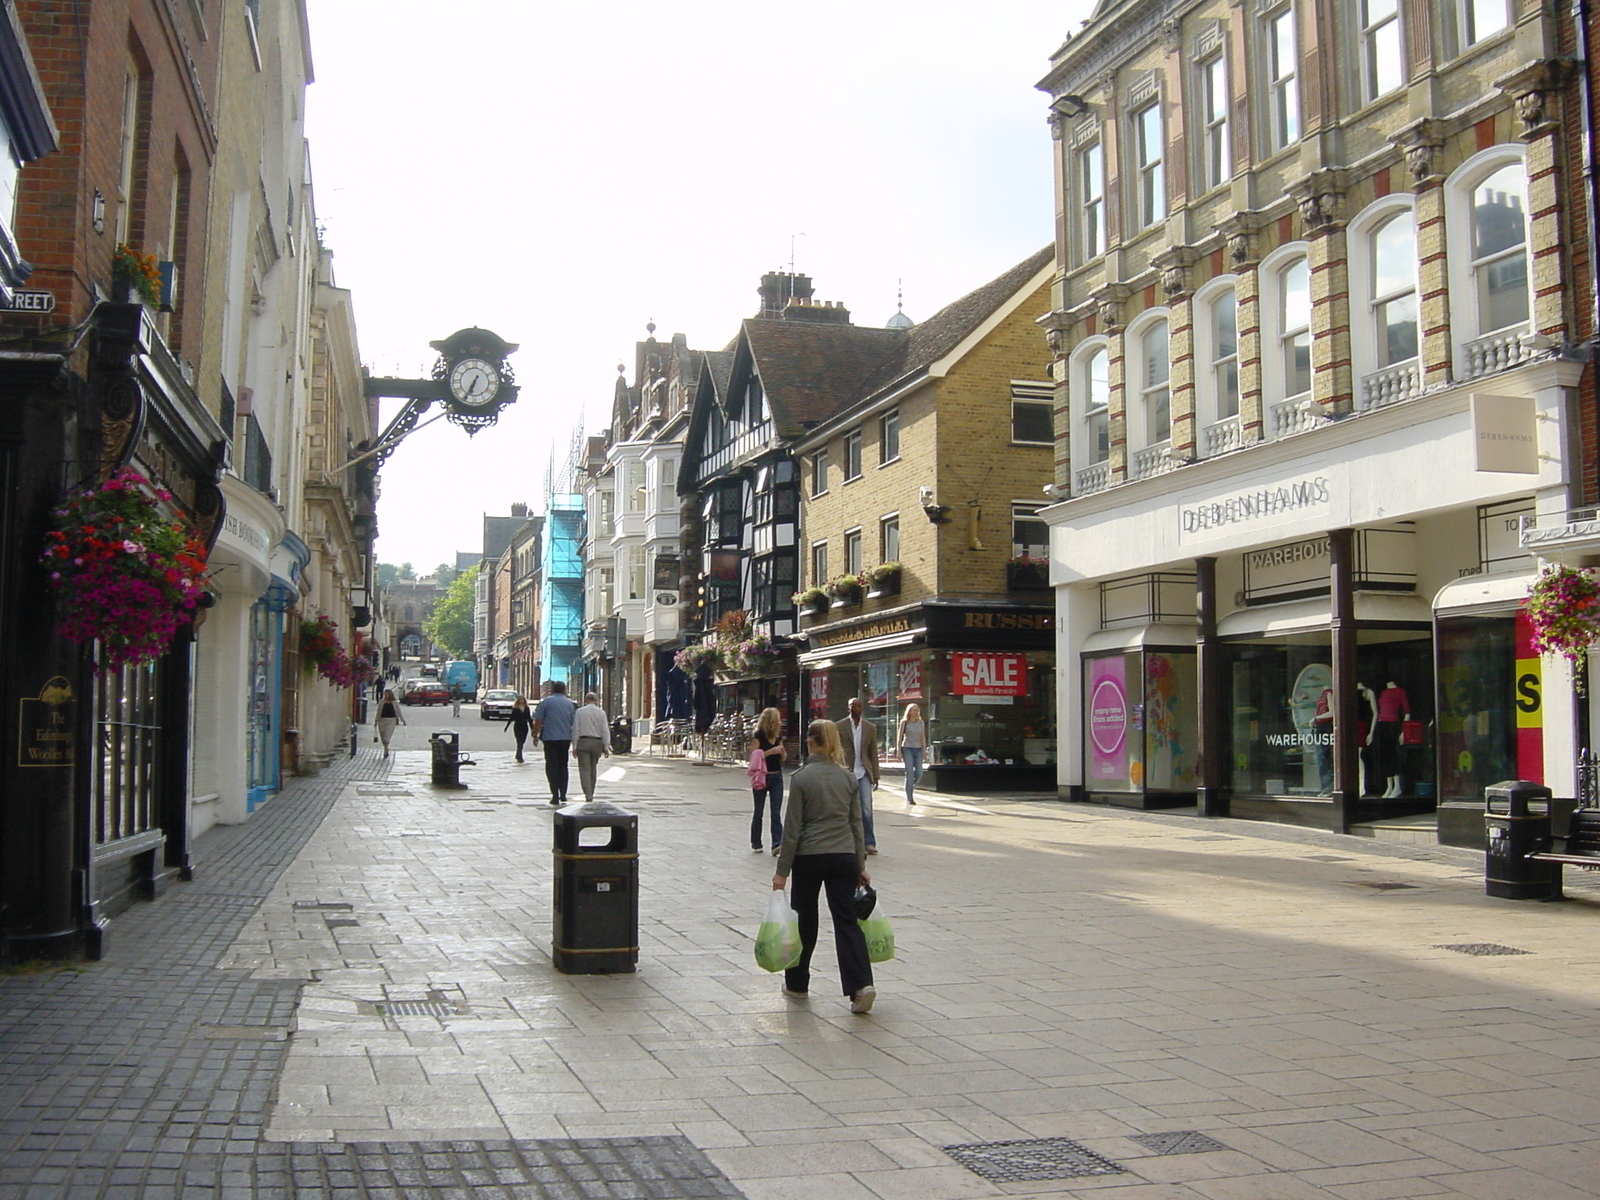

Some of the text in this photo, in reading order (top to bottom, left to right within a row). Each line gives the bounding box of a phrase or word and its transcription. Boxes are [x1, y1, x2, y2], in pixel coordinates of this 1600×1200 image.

[1480, 432, 1532, 442] DEBENHAMS
[1184, 477, 1324, 531] DEBENHAMS
[1505, 517, 1537, 532] TOSH
[962, 658, 1018, 686] SALE
[1516, 673, 1541, 713] S
[51, 711, 65, 724] The
[1265, 733, 1335, 746] WAREHOUSE
